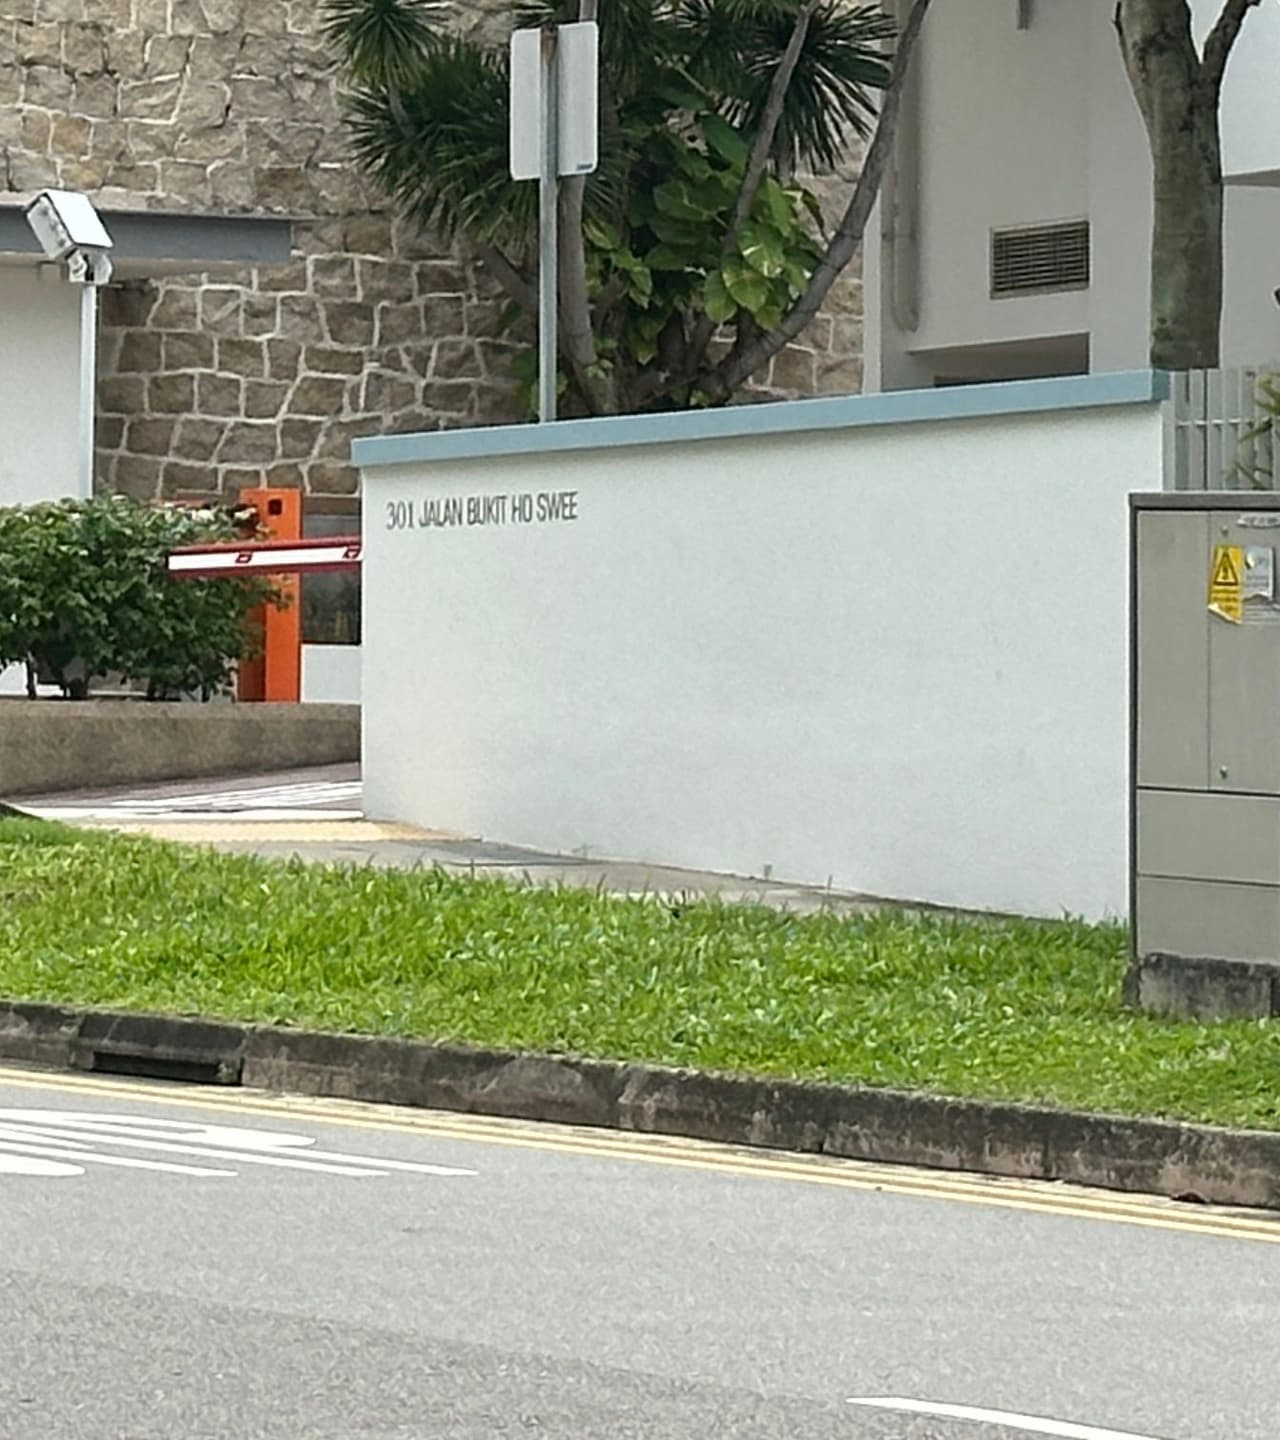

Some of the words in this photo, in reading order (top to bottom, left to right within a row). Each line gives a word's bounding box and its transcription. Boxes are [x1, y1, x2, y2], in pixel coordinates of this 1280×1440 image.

[386, 501, 414, 530] 301
[418, 497, 462, 527] JALAN
[467, 495, 507, 525] BUKIT
[511, 493, 533, 523] HO
[536, 491, 578, 521] SWEE
